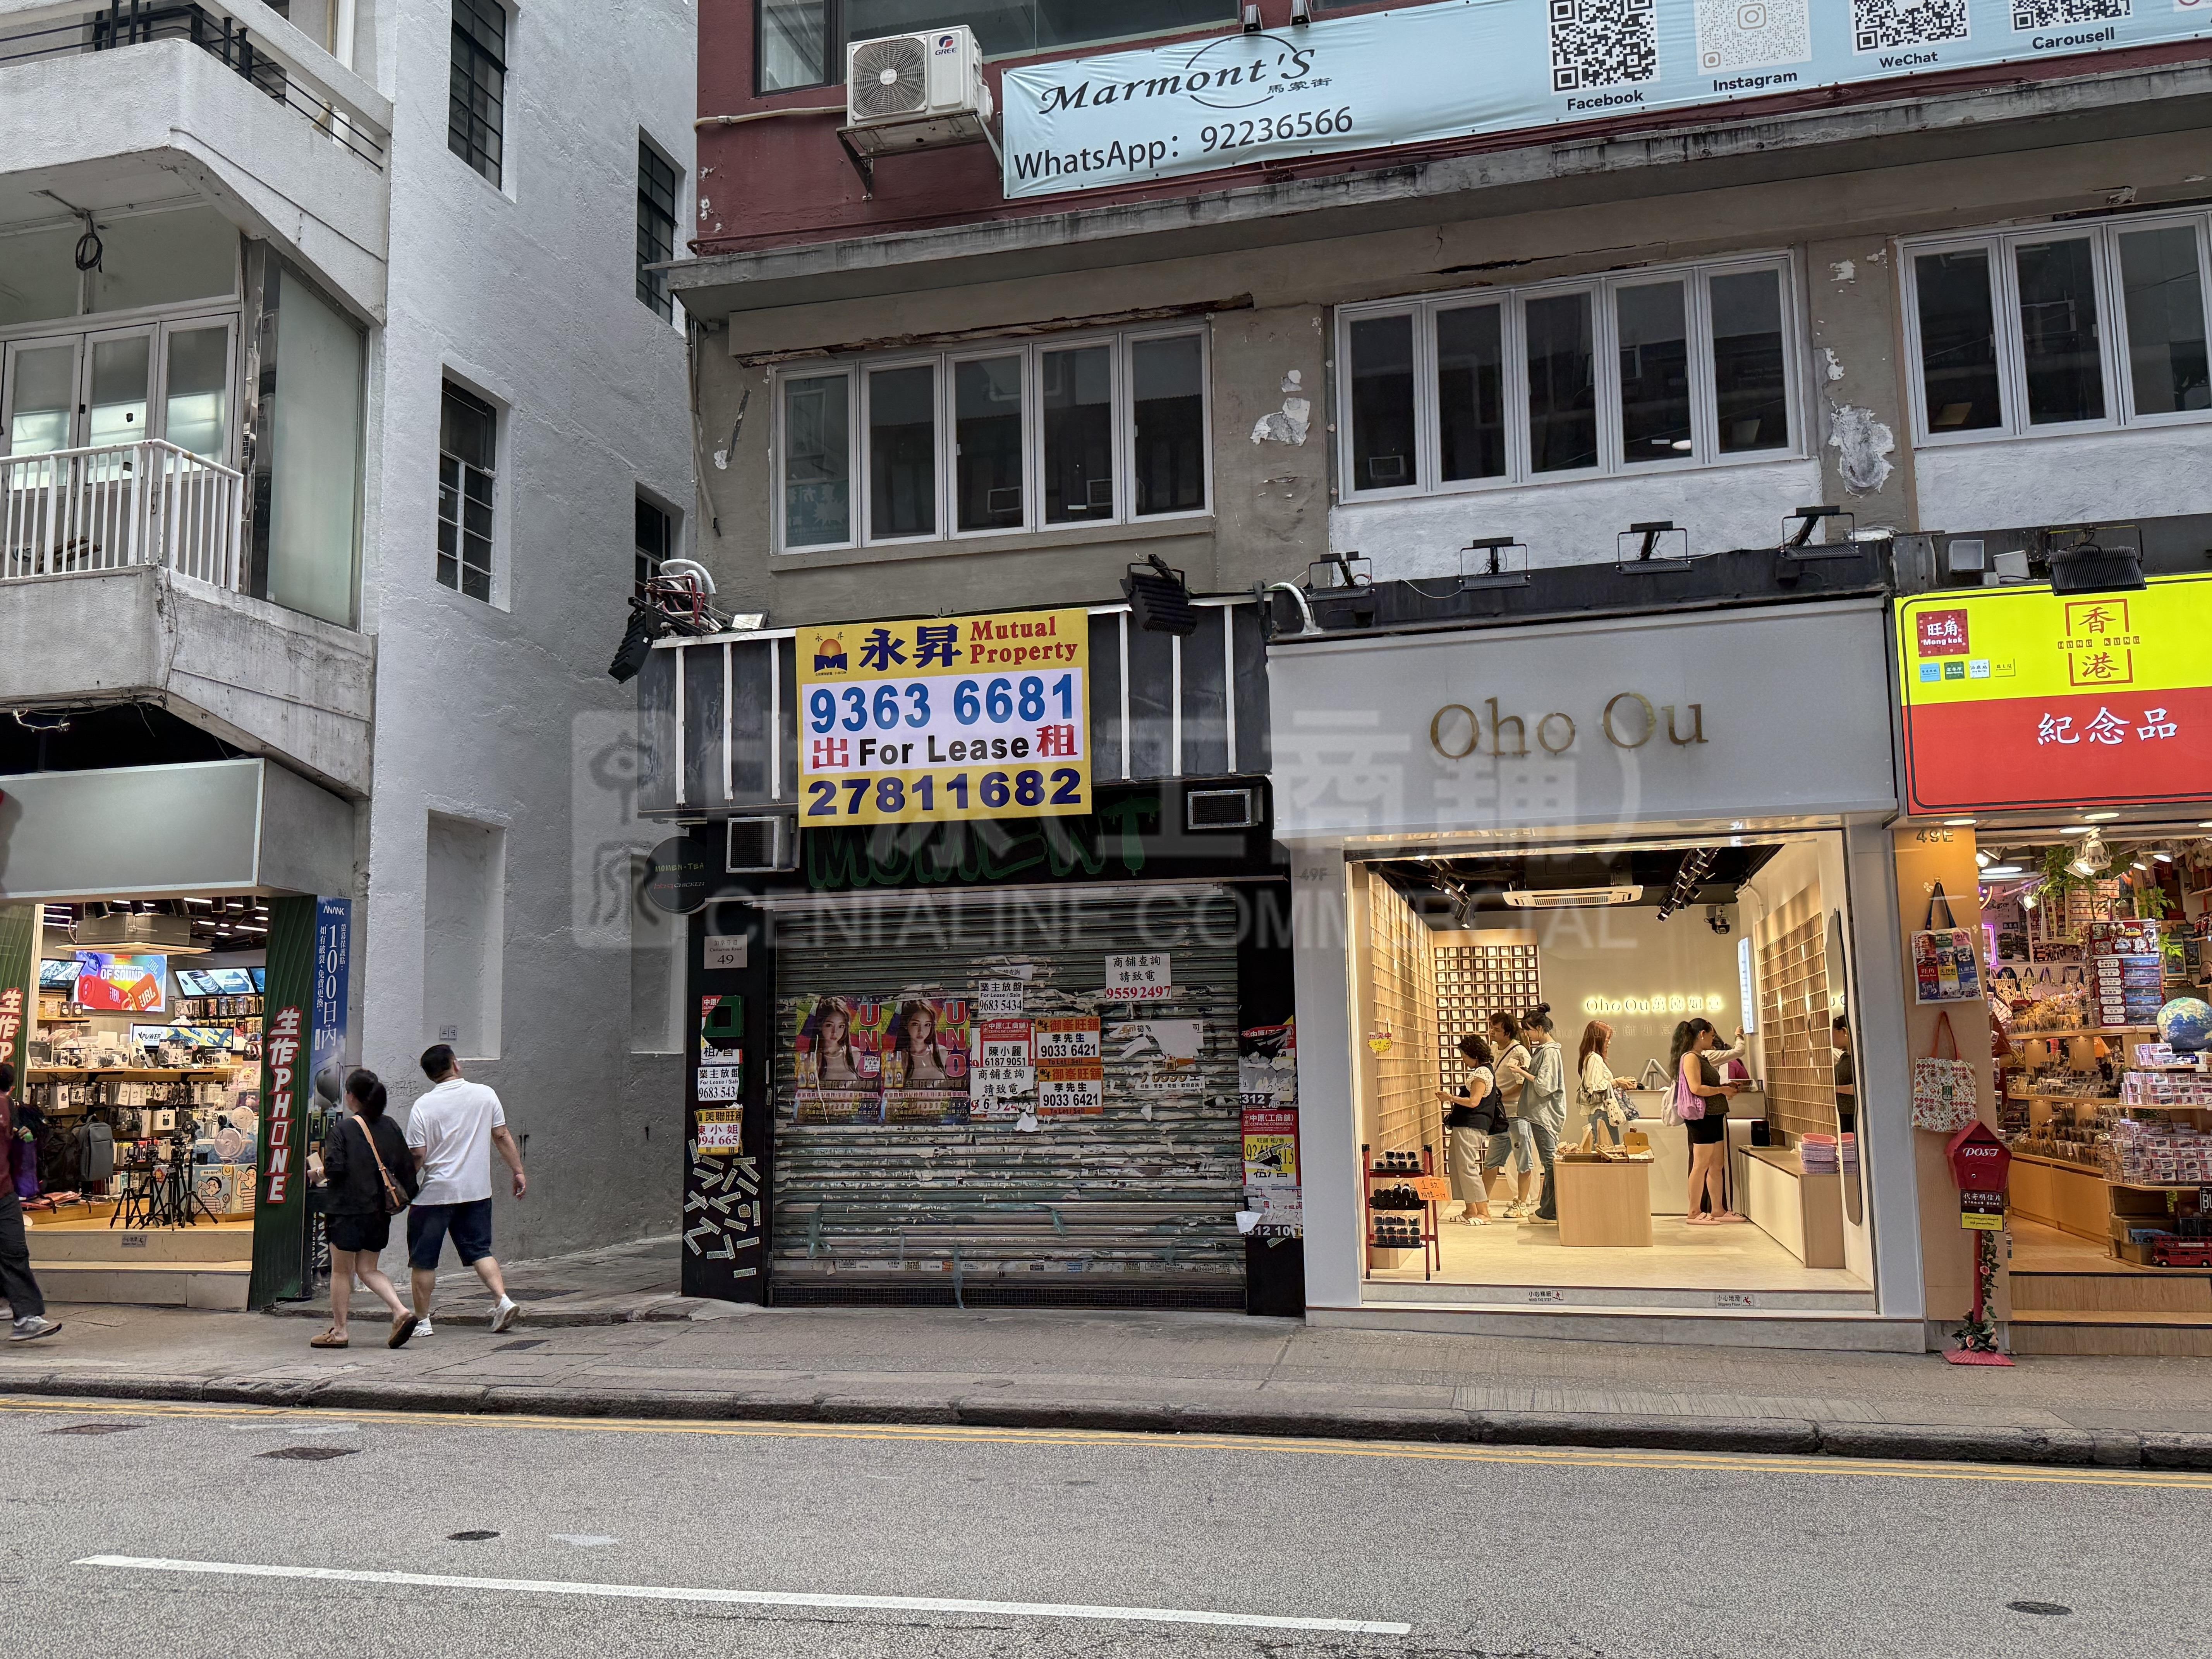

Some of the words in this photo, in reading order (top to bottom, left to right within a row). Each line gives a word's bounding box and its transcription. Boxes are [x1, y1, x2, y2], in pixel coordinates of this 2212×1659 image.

[2032, 27, 2115, 50] Carousell
[1879, 51, 1938, 68] WeChat
[1039, 49, 1315, 115] Marmont'S
[1713, 70, 1798, 92] Instagram
[1567, 89, 1644, 111] Facebook
[1200, 106, 1353, 153] 92236566
[970, 616, 1056, 641] Mutual
[1927, 620, 1958, 637] 旺角
[859, 623, 962, 671] 永昇
[970, 643, 1078, 665] Property
[810, 683, 931, 733] 9363
[953, 674, 1072, 725] 6681
[1430, 697, 1576, 760] Oho
[1602, 692, 1709, 750] Ou
[2037, 706, 2178, 746] 紀念品
[1036, 724, 1078, 757] 租
[812, 737, 849, 769] 出
[859, 738, 914, 766] For
[928, 735, 1029, 763] Lease
[807, 769, 1082, 816] 27811682
[1916, 829, 1954, 843] 49E
[147, 959, 159, 975] JBL
[717, 955, 733, 964] 49
[1113, 955, 1161, 968] 商舖查詢
[100, 968, 112, 980] OF
[114, 969, 143, 981] SOUND
[1120, 970, 1155, 982] 請致電
[980, 982, 1022, 992] 業主放盤
[1106, 986, 1171, 1000] 95592497
[110, 987, 121, 1004] JBL
[138, 987, 156, 1008] JBL
[980, 1000, 998, 1011] 9683
[1001, 1000, 1022, 1011] 5434
[1587, 998, 1620, 1011] Oho
[1626, 999, 1648, 1011] Ou
[1052, 1033, 1085, 1043] 李先生
[1041, 1045, 1066, 1057] 9033
[1071, 1044, 1096, 1056] 6421
[985, 1058, 1005, 1066] 6187
[1007, 1057, 1025, 1066] 9051
[978, 1068, 1024, 1080] 商舖查詢
[699, 1087, 718, 1099] 9683
[984, 1083, 1018, 1097] 請致電
[1054, 1082, 1087, 1092] 李先生
[1043, 1094, 1069, 1106] 9033
[1073, 1093, 1097, 1106] 6421
[1963, 1147, 1999, 1157] POST
